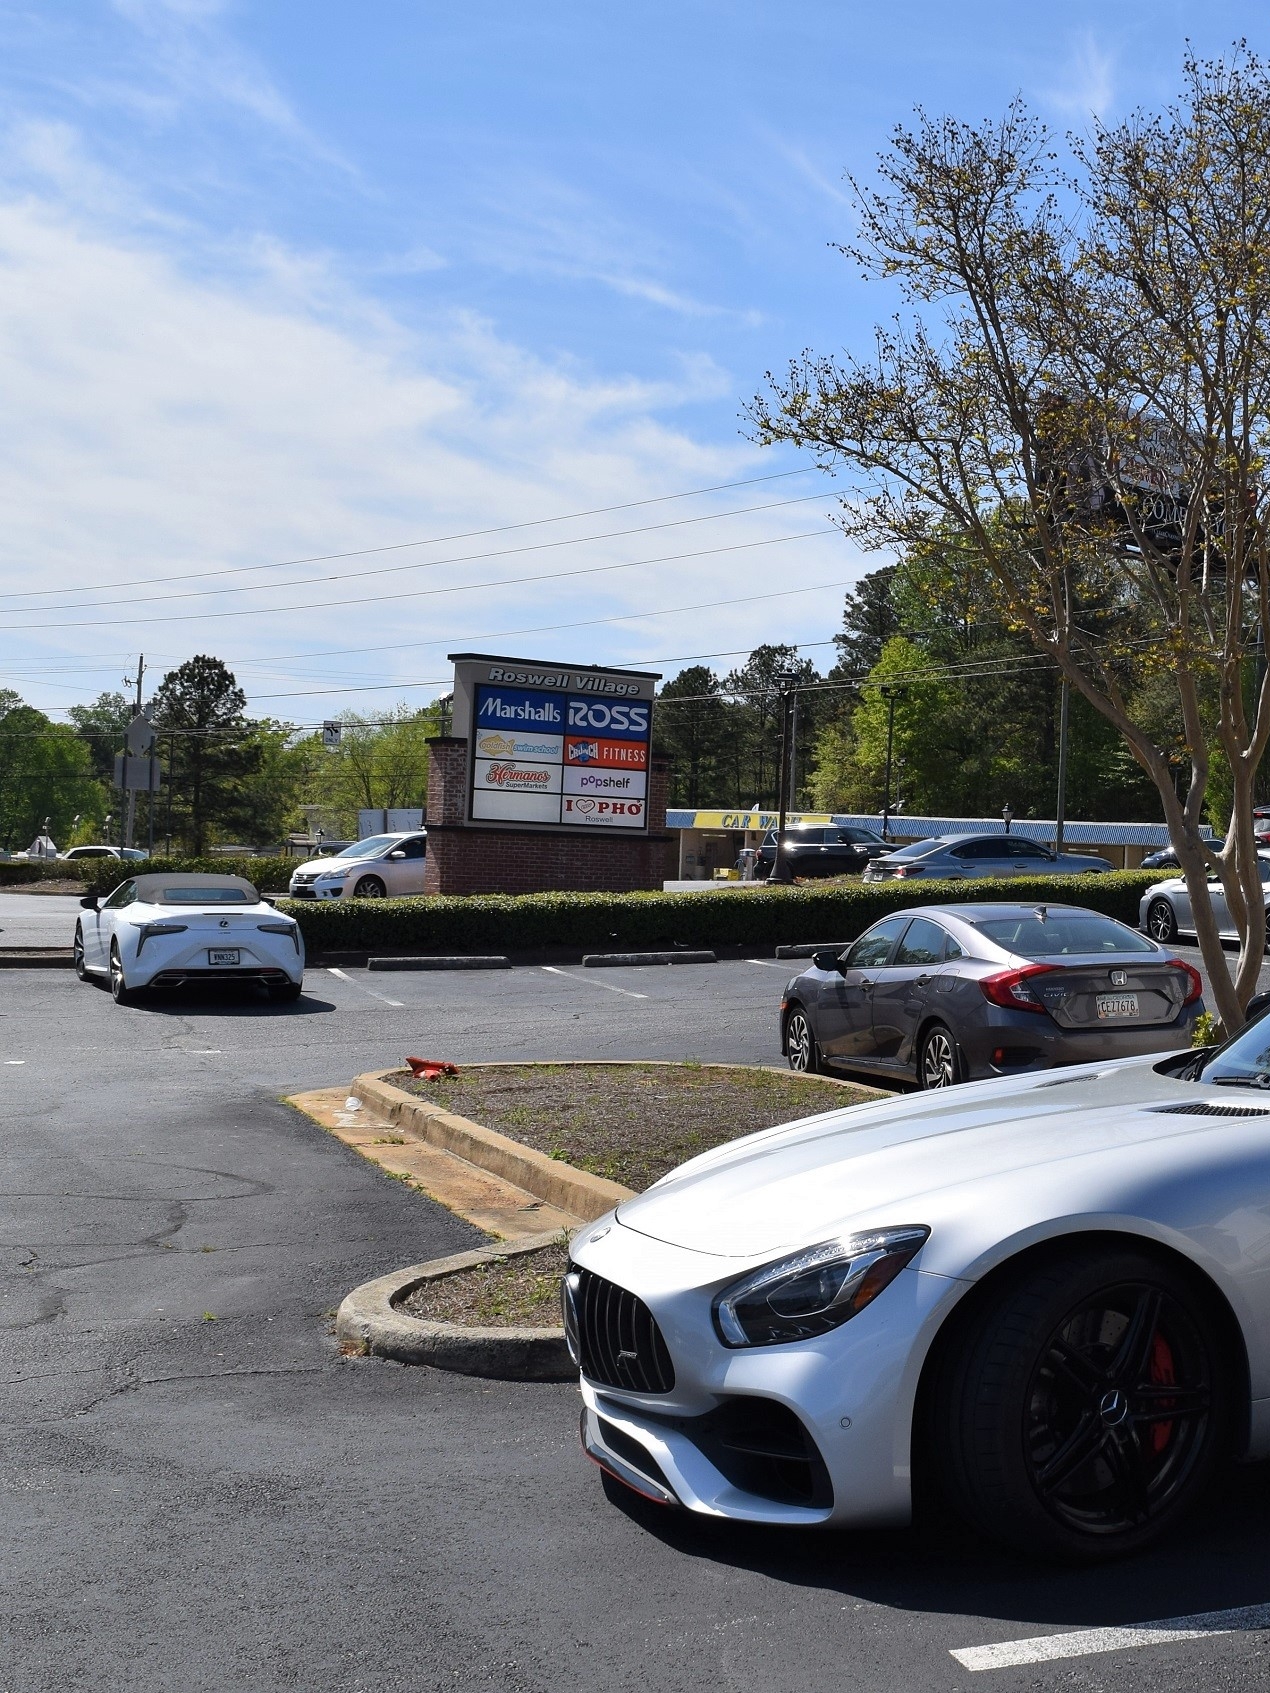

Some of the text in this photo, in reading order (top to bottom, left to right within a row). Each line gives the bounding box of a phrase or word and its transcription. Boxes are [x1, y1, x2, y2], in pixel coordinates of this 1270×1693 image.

[488, 667, 640, 696] Roswell Village
[479, 697, 561, 722] Marshalls
[568, 701, 648, 732] ROSS
[513, 743, 534, 752] swim
[534, 745, 559, 755] school
[568, 742, 646, 763] CRUNCH FITNESS
[580, 775, 631, 789] popshelf
[565, 799, 574, 812] I
[585, 815, 614, 824] Roswell
[722, 814, 751, 828] CAR
